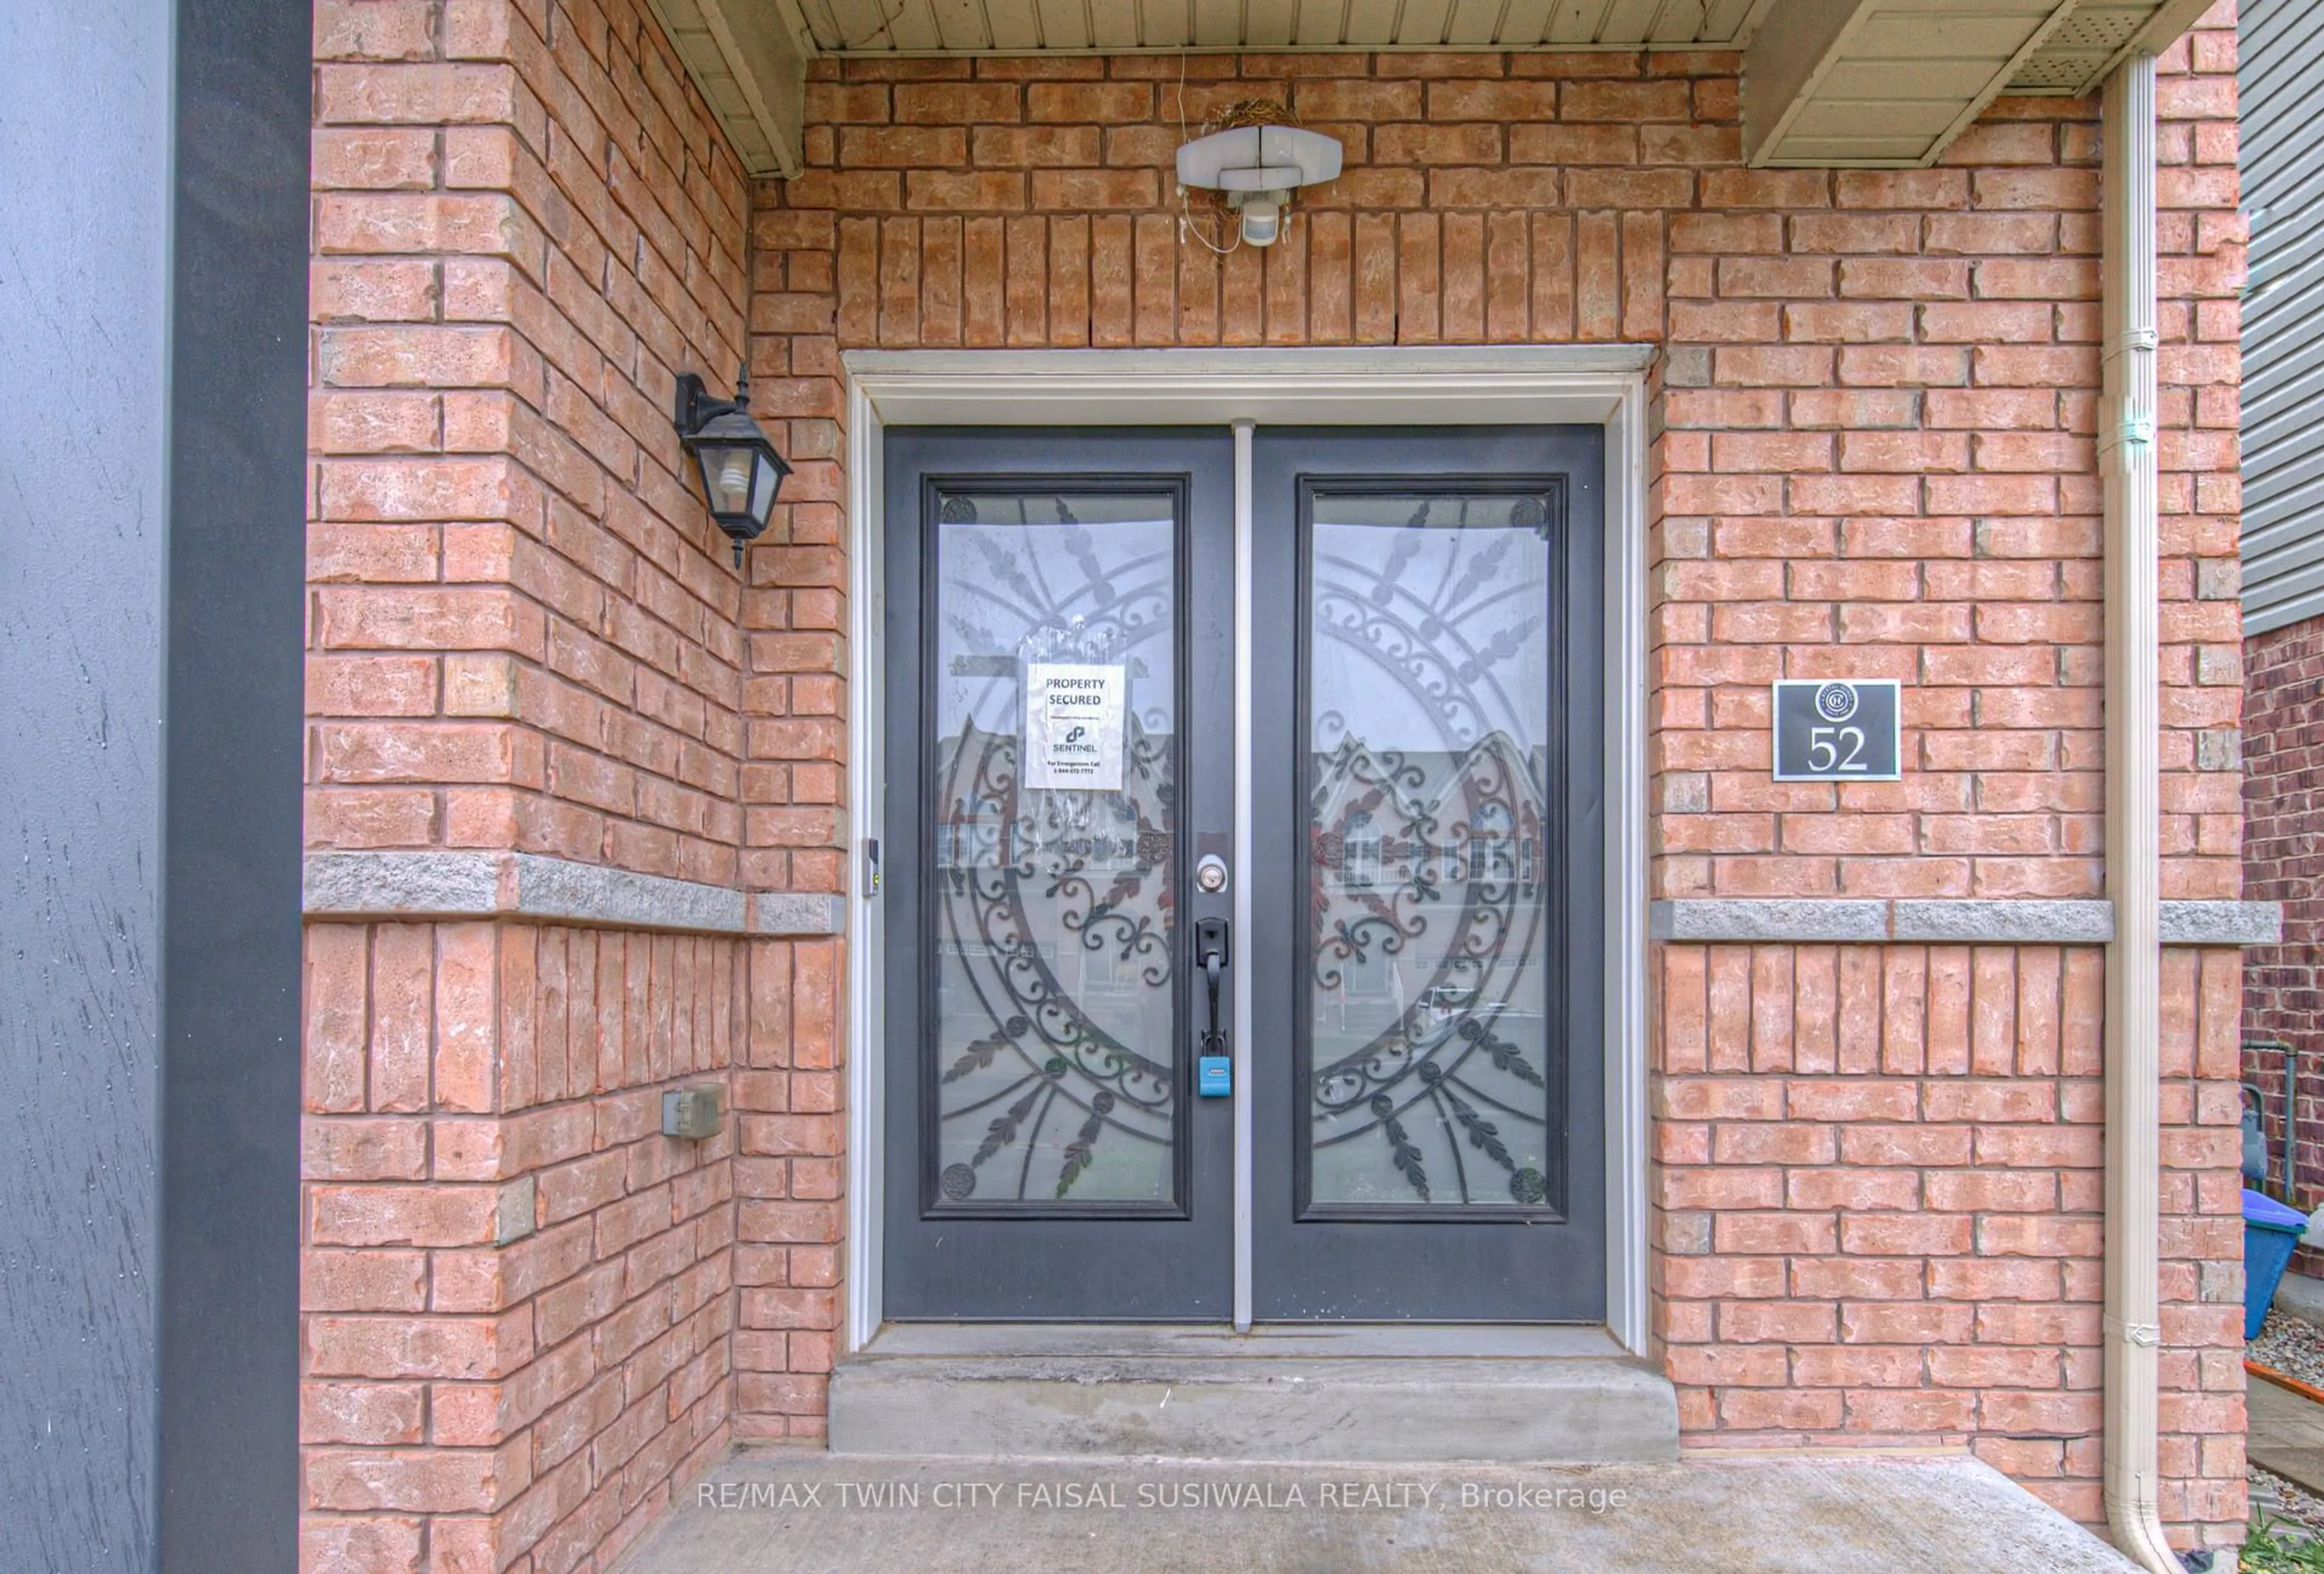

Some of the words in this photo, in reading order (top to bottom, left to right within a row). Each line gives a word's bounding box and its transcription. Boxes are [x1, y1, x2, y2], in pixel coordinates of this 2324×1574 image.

[1046, 678, 1105, 689] PROPERTY
[1049, 694, 1101, 705] SECURED
[1053, 744, 1097, 752] SENTINEL
[1808, 726, 1868, 772] 52
